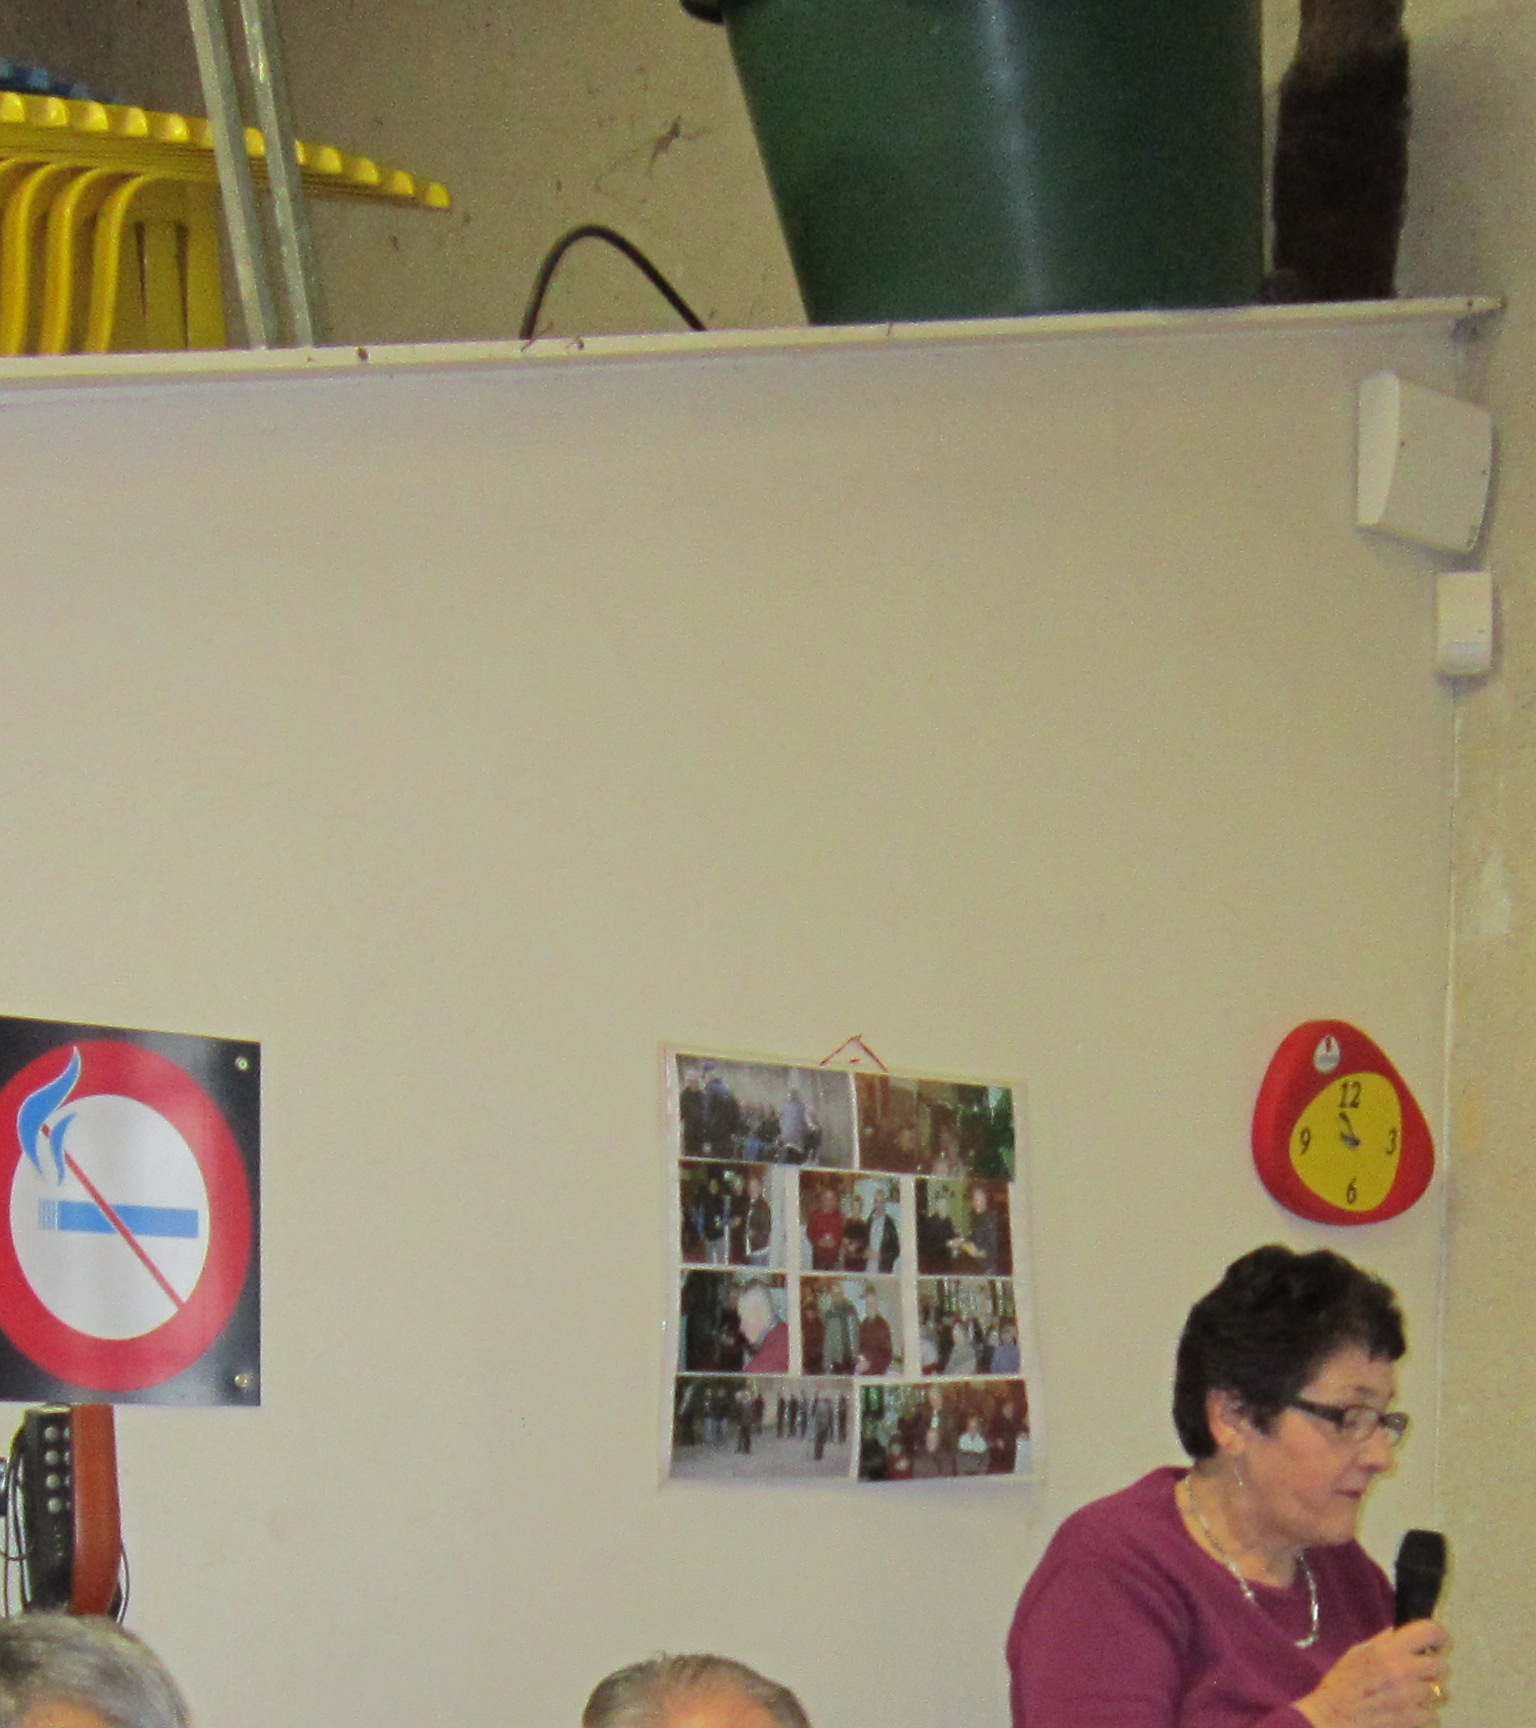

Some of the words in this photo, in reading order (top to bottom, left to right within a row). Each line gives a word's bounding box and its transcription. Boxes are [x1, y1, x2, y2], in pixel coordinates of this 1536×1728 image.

[1339, 1081, 1362, 1109] 12
[1300, 1127, 1312, 1156] 9
[1385, 1127, 1397, 1156] 3
[1345, 1177, 1358, 1205] 6
